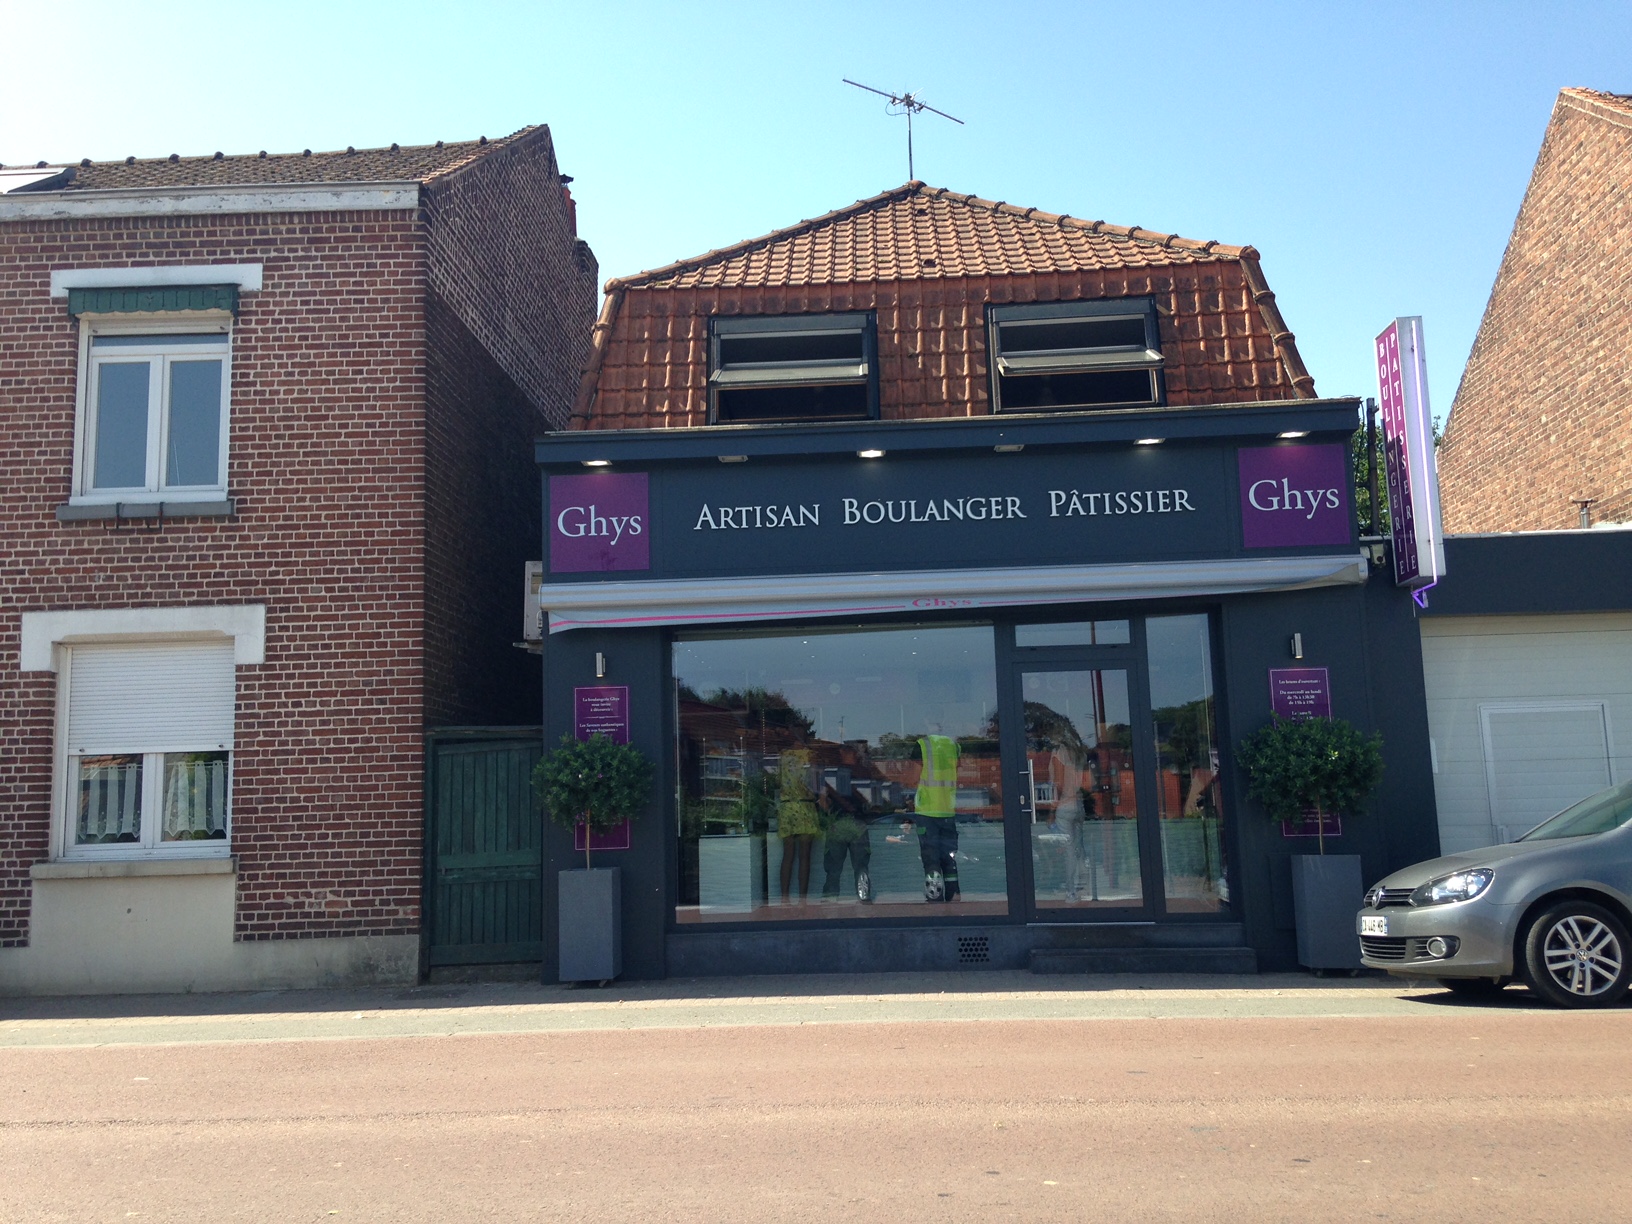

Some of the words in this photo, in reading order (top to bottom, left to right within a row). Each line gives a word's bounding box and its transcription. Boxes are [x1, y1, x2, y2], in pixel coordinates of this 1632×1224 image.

[1379, 342, 1405, 575] BOULANGERIE
[1390, 332, 1417, 570] PATISSERIE
[693, 503, 821, 530] ARTISAN
[842, 496, 1027, 525] BOULANGER
[1048, 489, 1196, 517] PÂTISSIER
[1248, 477, 1340, 520] Ghys
[557, 505, 642, 545] Ghys
[912, 598, 972, 608] Ghys
